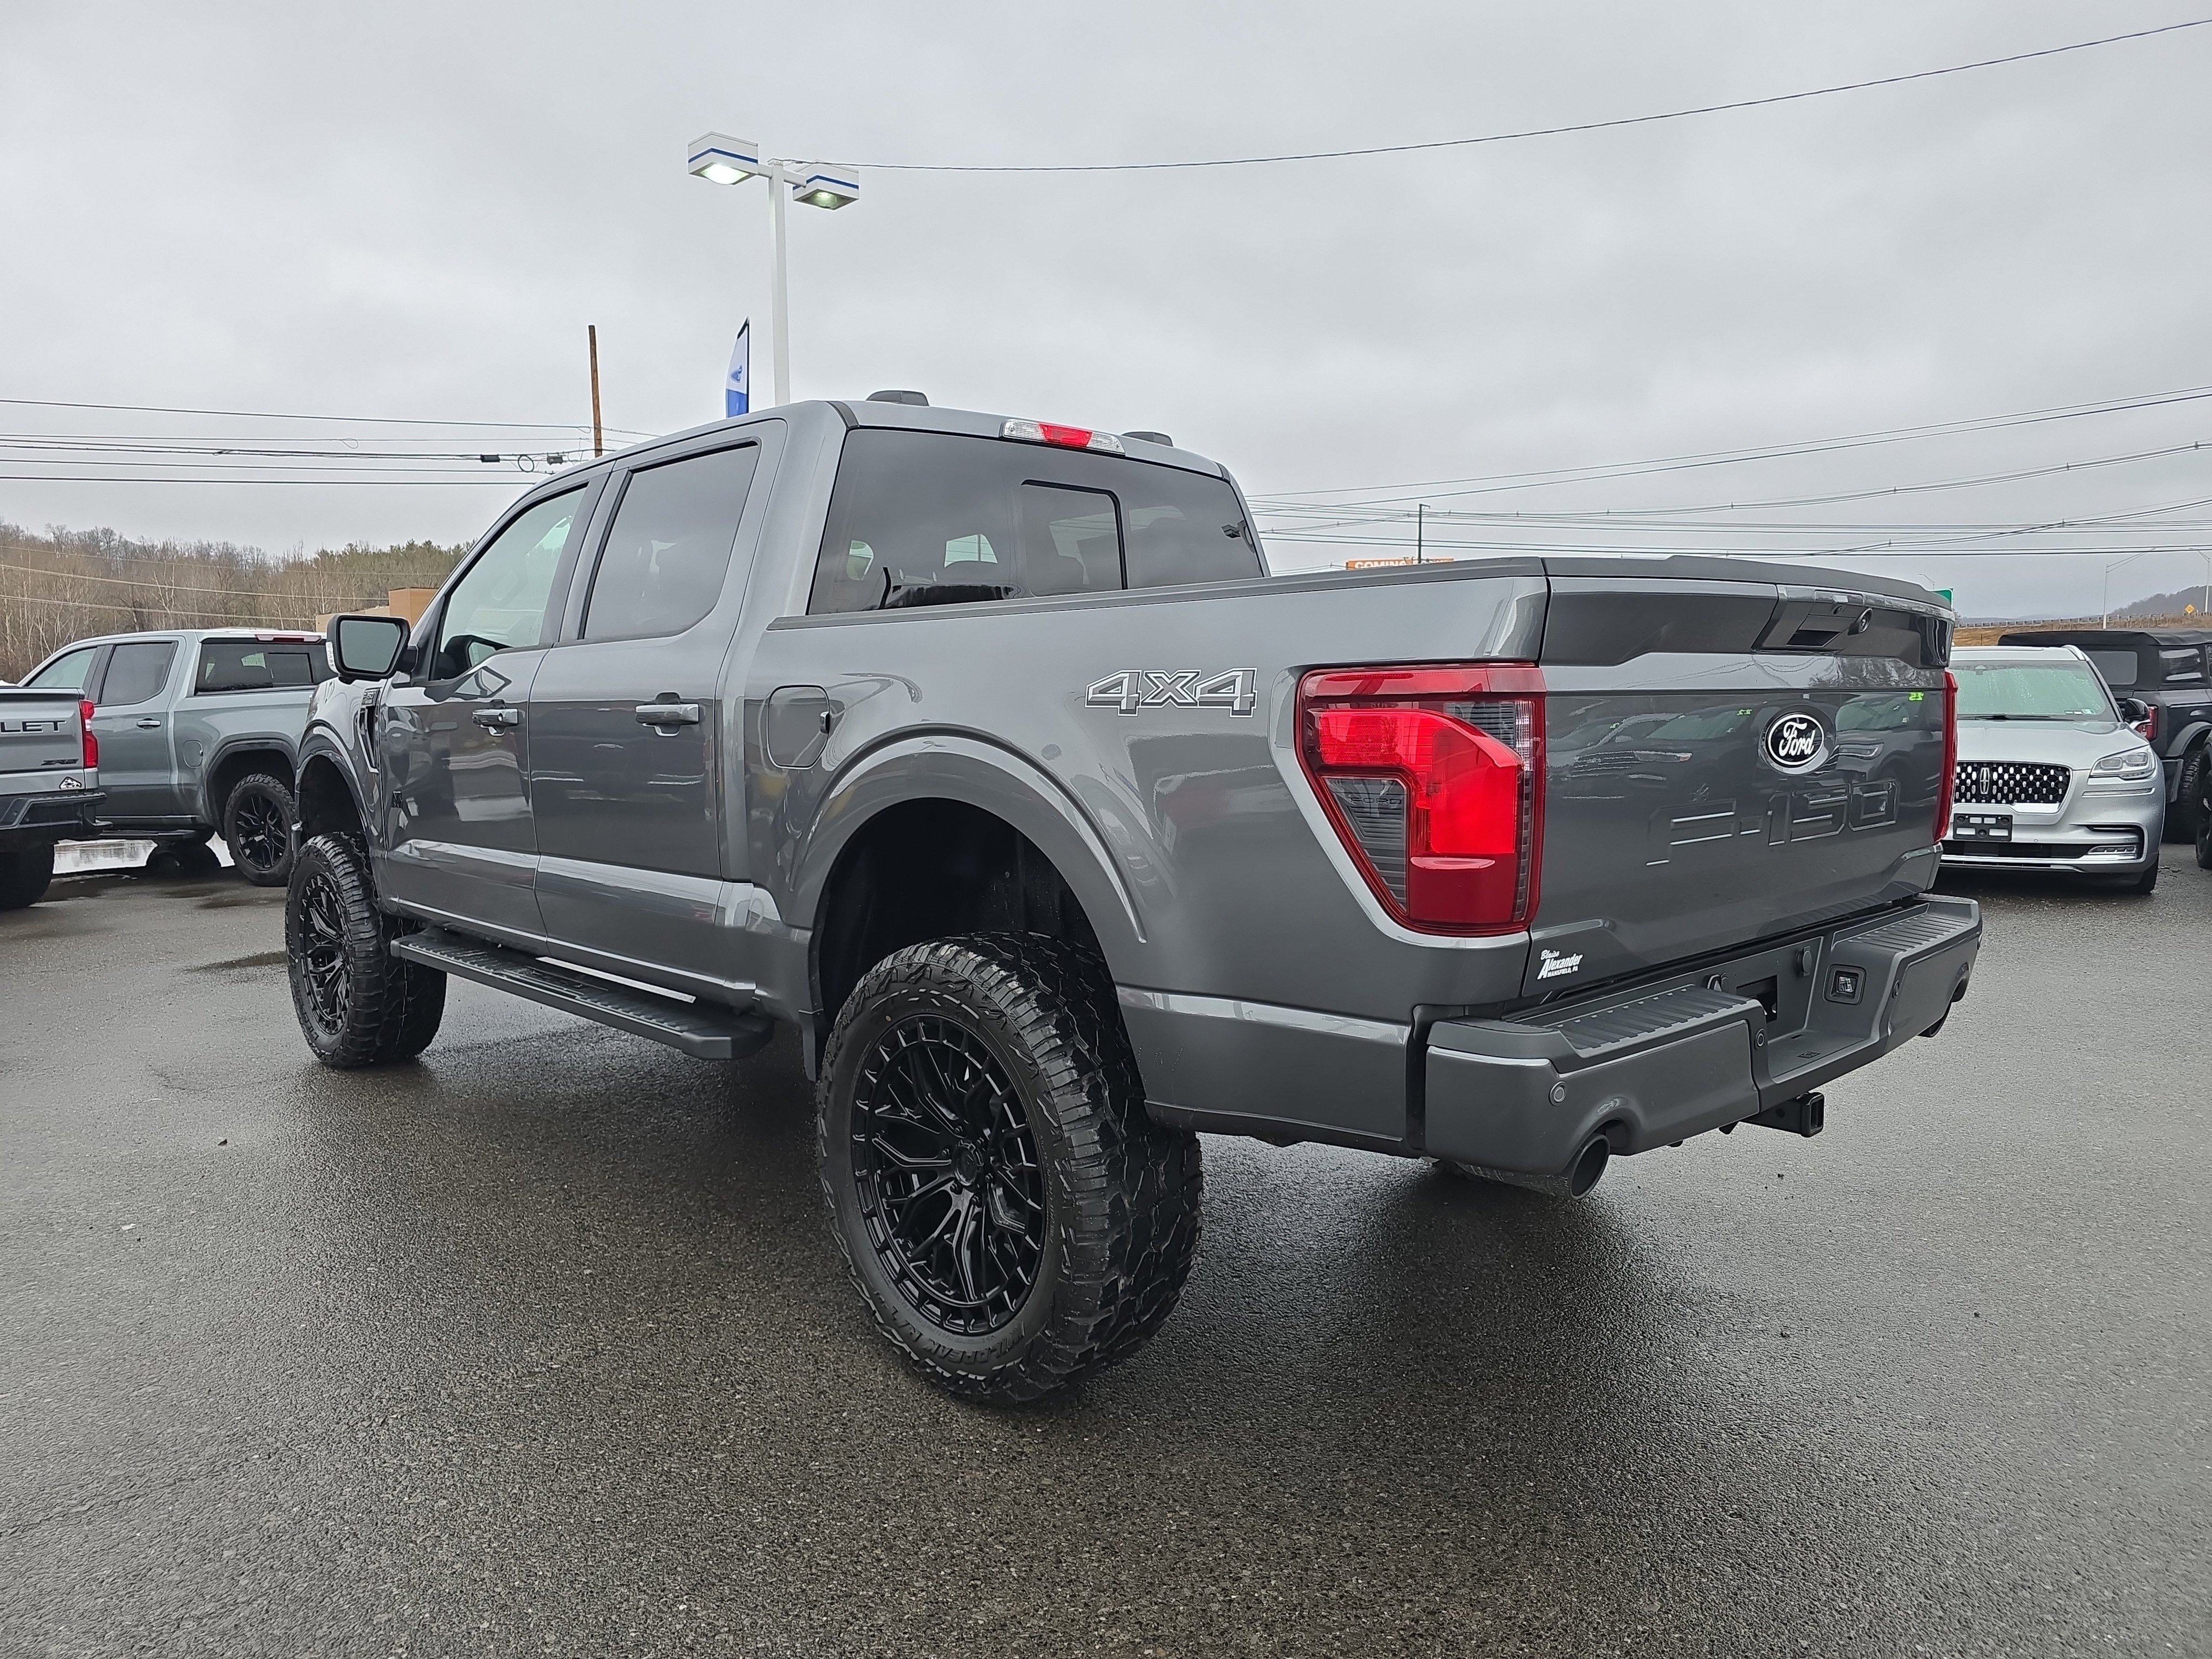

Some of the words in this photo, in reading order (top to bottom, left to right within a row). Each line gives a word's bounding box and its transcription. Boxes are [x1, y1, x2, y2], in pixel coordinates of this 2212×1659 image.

[1779, 722, 1816, 757] Ford
[1646, 779, 1900, 866] F-150
[1537, 953, 1583, 980] Alexander
[1540, 949, 1560, 960] Blaise
